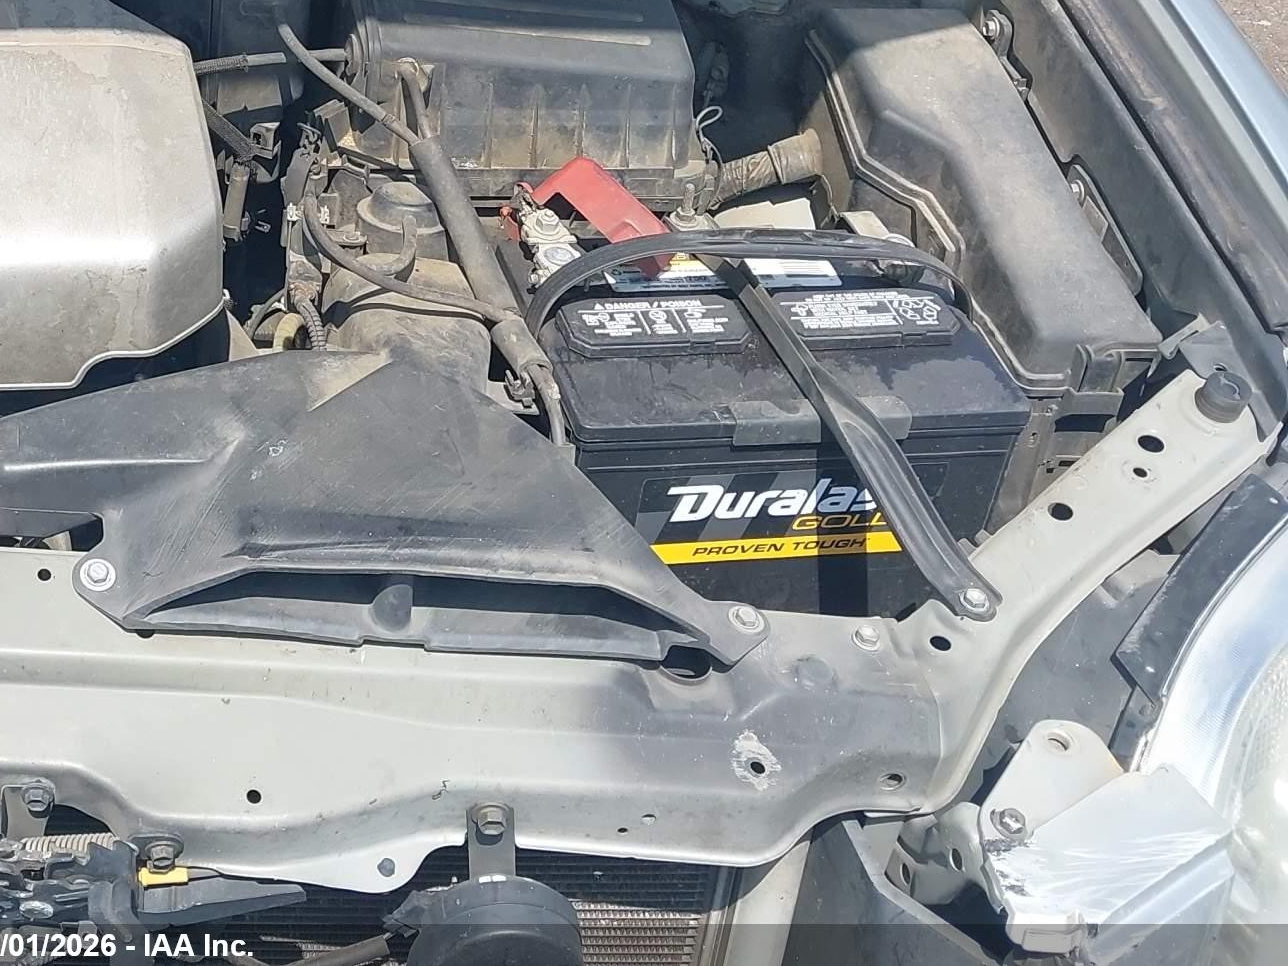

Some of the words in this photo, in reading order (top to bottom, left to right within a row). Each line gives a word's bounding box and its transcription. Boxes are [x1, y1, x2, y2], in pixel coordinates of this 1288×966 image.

[604, 301, 651, 309] DANGER
[660, 299, 702, 308] POISON
[667, 478, 878, 523] Duralas
[692, 544, 786, 557] PROVEN
[792, 538, 865, 551] TOUGH
